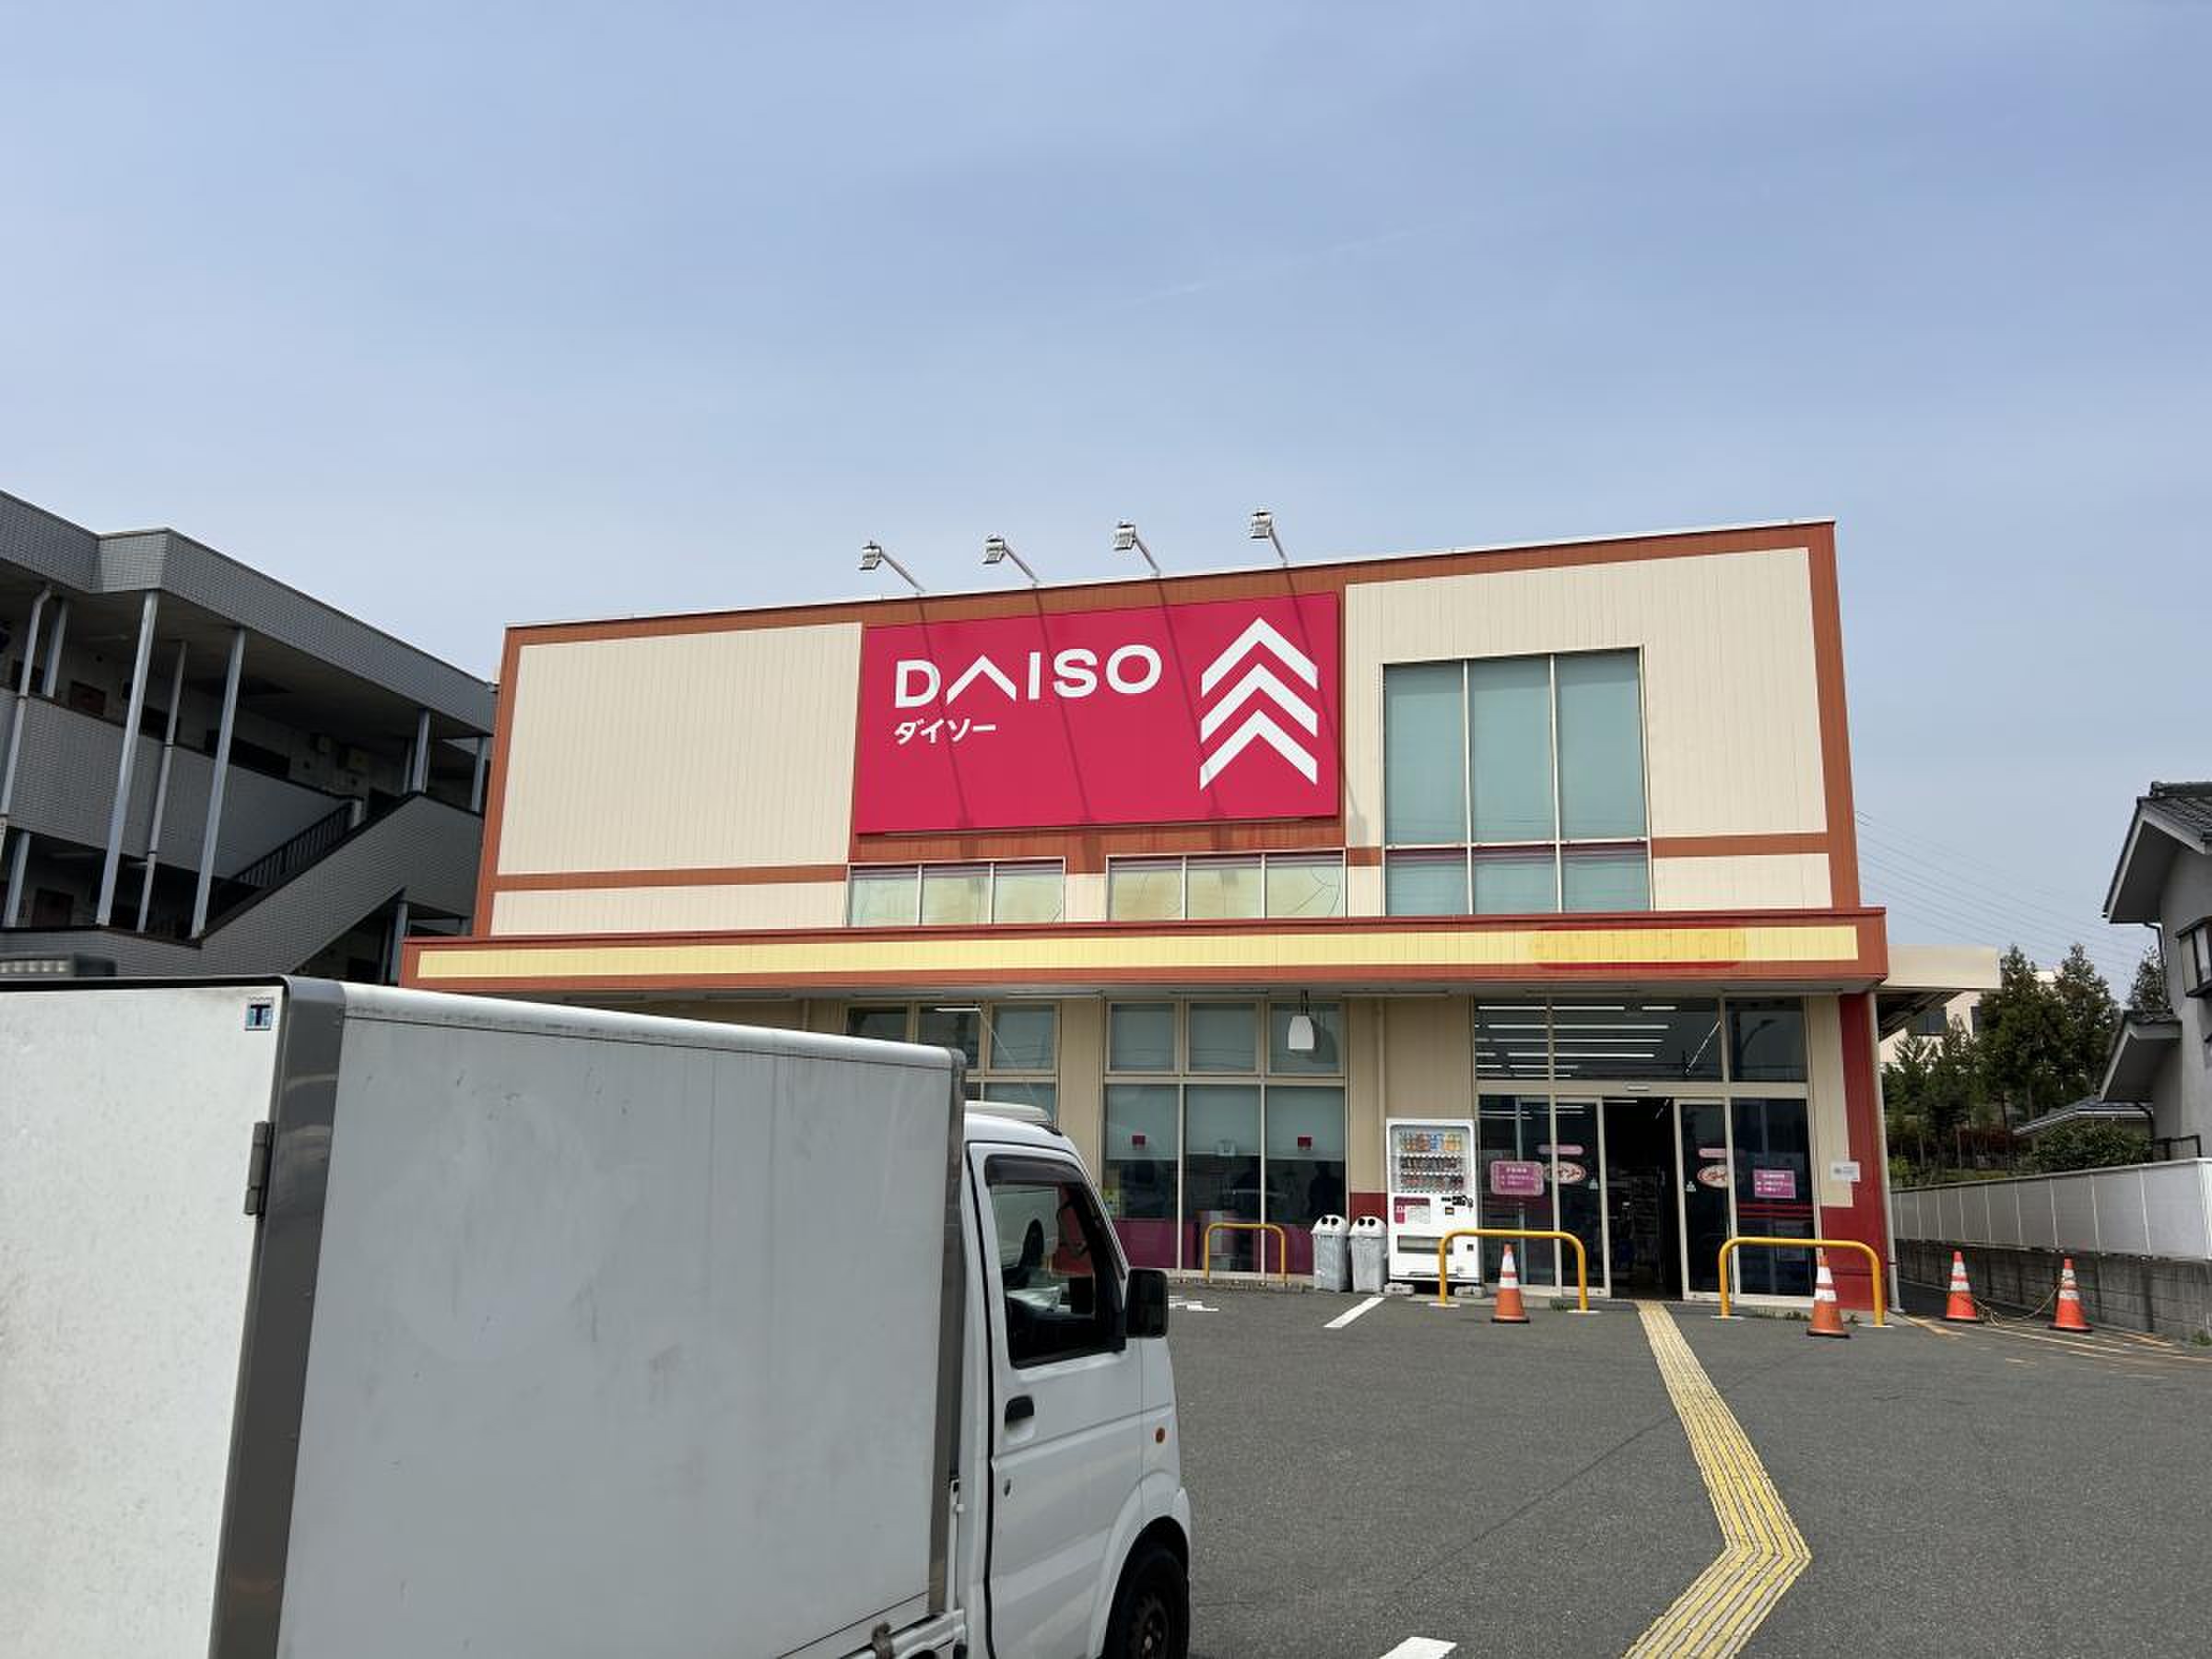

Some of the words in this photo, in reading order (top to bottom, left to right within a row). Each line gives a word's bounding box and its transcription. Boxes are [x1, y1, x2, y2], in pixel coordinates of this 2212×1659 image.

[896, 645, 1161, 708] DAISO
[895, 719, 995, 744] ダイソー
